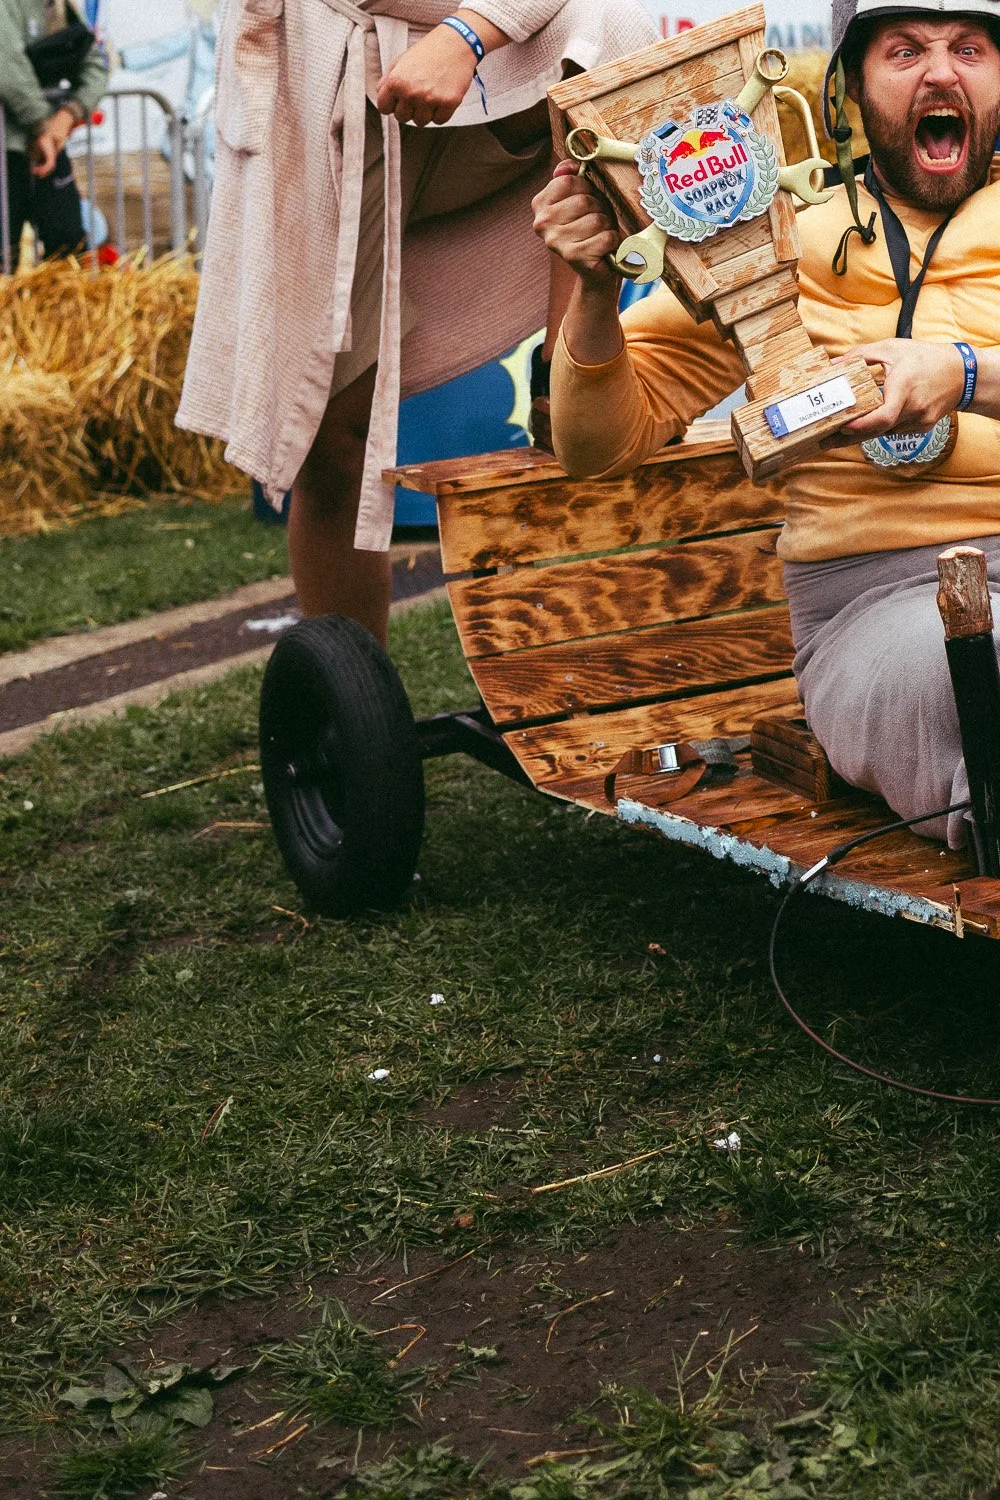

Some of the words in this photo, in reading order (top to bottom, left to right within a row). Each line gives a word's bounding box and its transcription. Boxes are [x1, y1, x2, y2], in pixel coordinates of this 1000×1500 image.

[664, 160, 709, 194] Red
[705, 143, 749, 176] Bull
[683, 168, 746, 206] SOAPBOX
[703, 190, 739, 216] RACE
[806, 391, 825, 408] 1st
[895, 441, 917, 452] RACE
